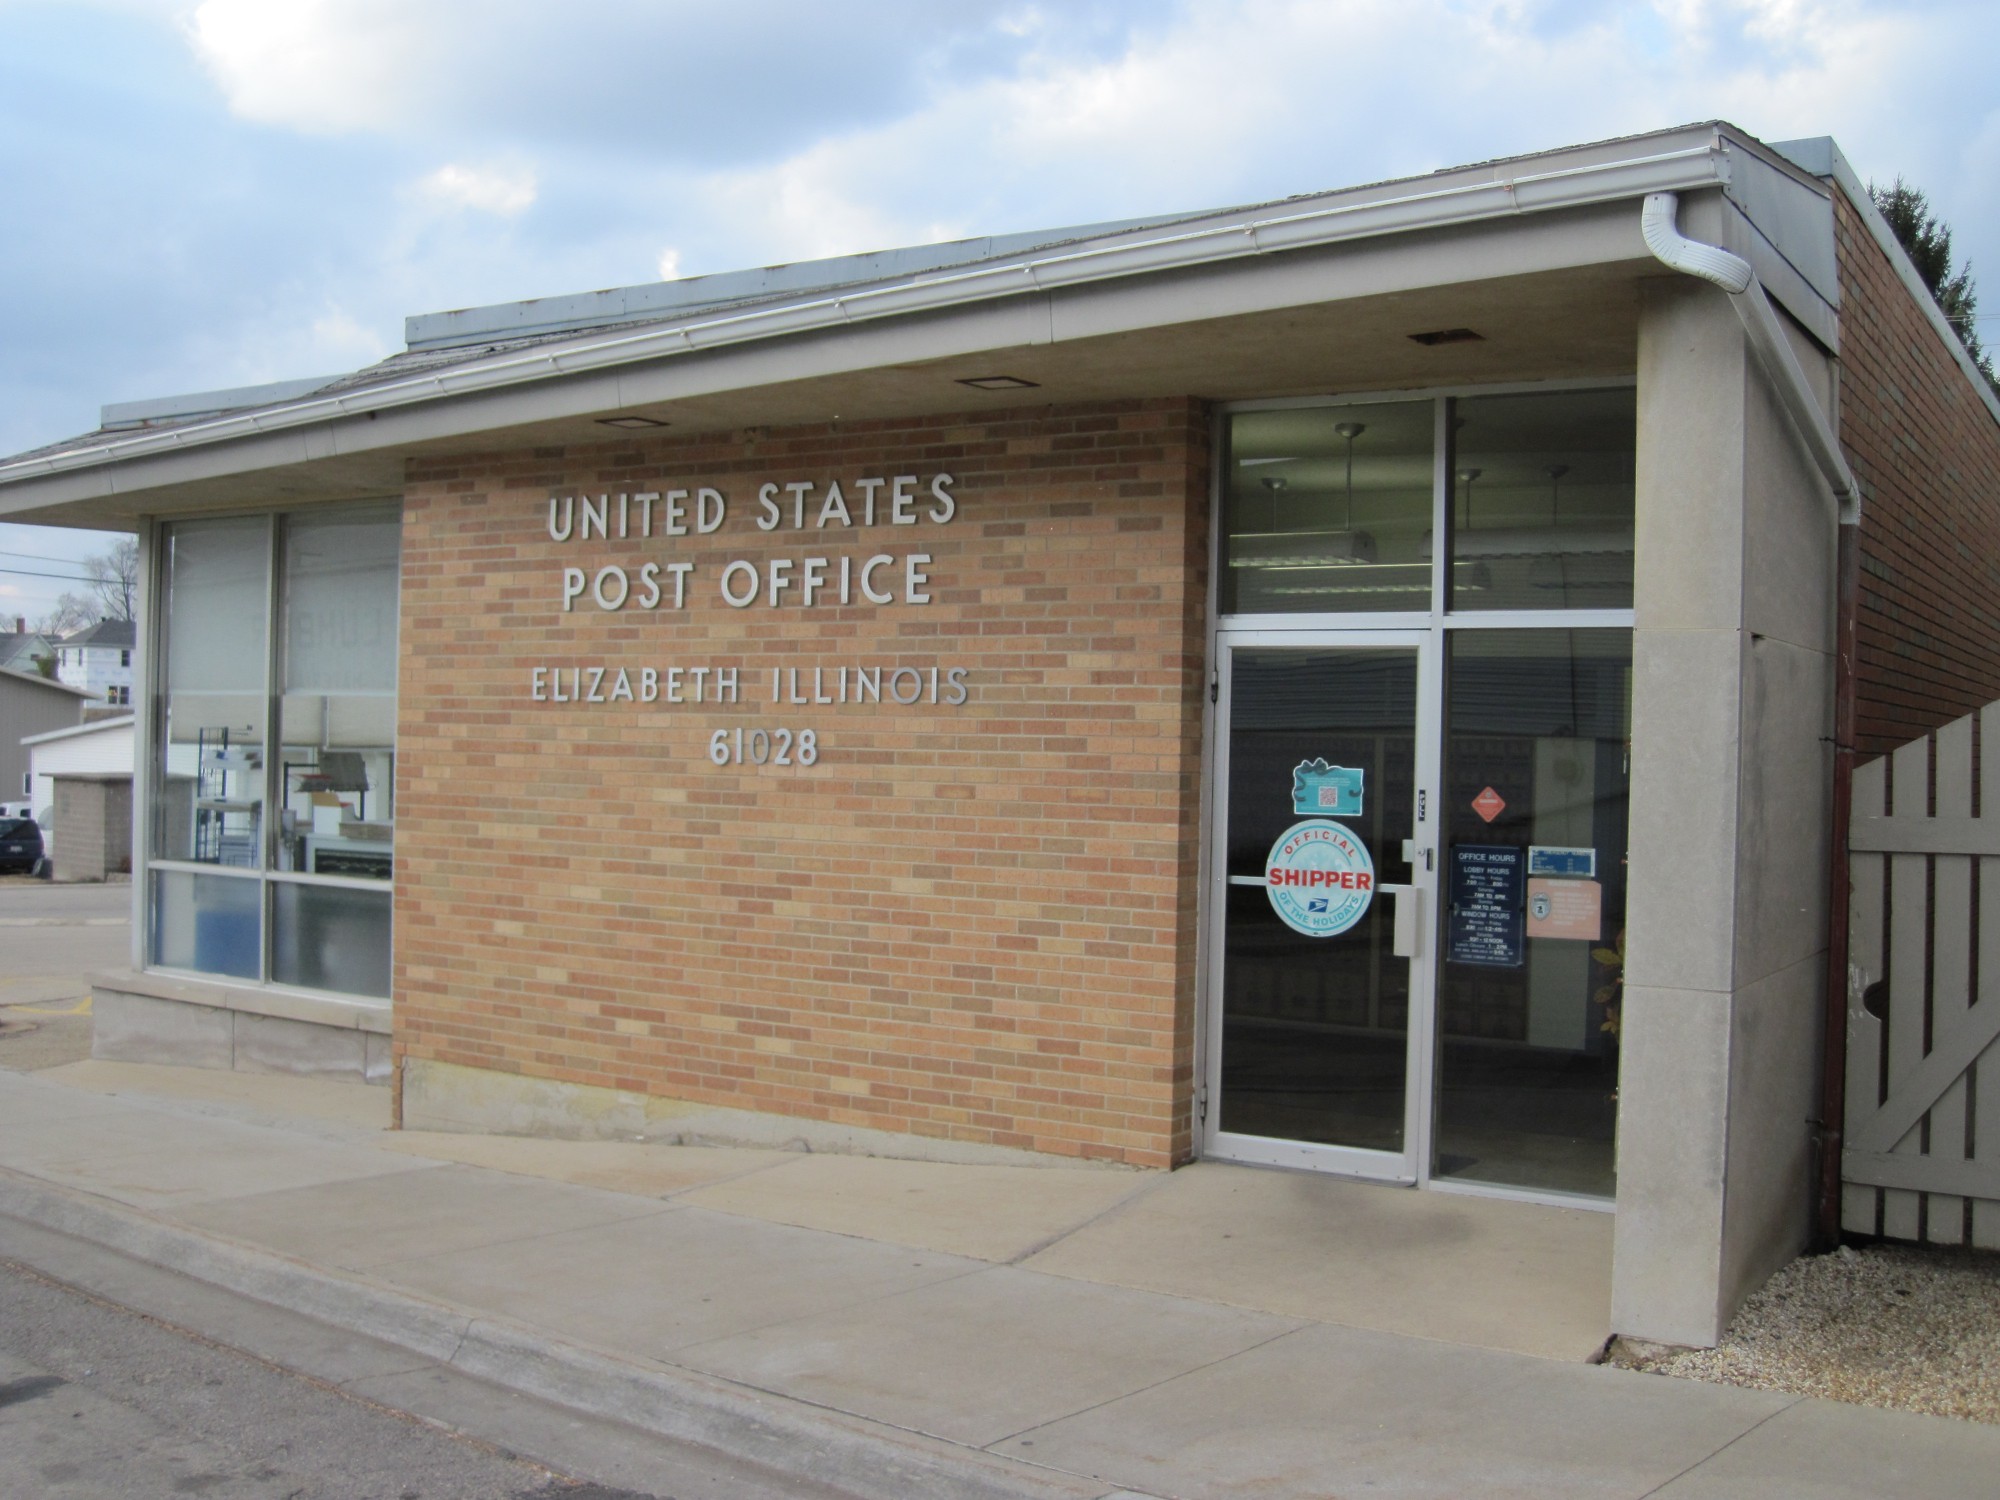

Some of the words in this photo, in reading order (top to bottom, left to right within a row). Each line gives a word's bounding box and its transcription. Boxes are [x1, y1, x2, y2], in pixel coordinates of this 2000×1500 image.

[549, 487, 727, 542] UNITED
[756, 473, 957, 531] STATES
[563, 562, 694, 611] POST
[720, 554, 932, 607] OFFICE
[531, 666, 738, 703] ELIZABETH
[772, 665, 969, 705] ILLINOIS
[709, 727, 818, 767] 61028
[1284, 830, 1355, 858] OFFICIAL
[1458, 852, 1486, 861] OFFICE
[1488, 854, 1516, 863] HOURS
[1268, 867, 1372, 891] SHIPPER
[1463, 866, 1485, 874] LOBBY
[1487, 867, 1510, 875] HOURS
[1279, 891, 1291, 906] OF
[1291, 906, 1309, 925] THE
[1312, 896, 1360, 927] HOLIDAYS
[1461, 910, 1487, 918] WINDOW
[1489, 912, 1511, 920] HOURS
